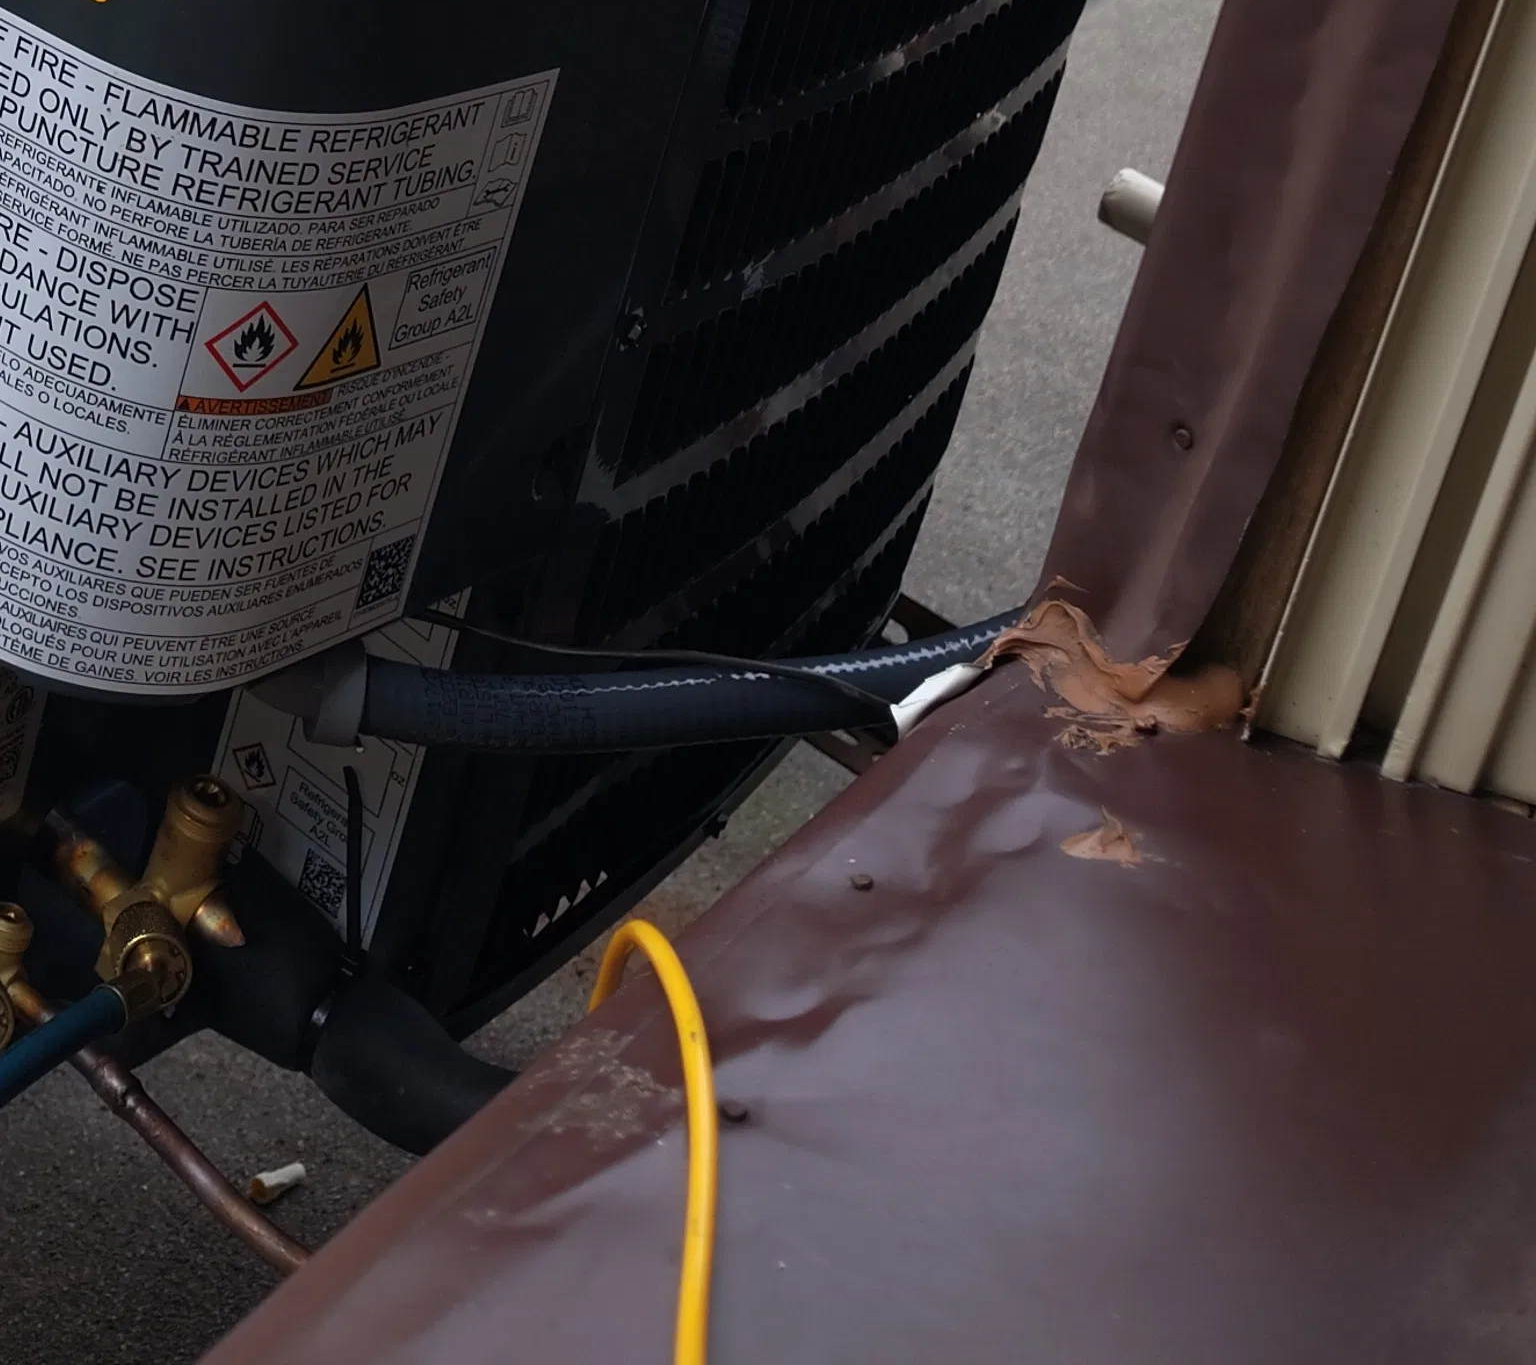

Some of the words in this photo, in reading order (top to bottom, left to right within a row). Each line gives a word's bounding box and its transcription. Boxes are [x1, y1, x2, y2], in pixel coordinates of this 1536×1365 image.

[13, 35, 79, 80] FIRE
[103, 80, 302, 153] FLAMMABLE
[307, 101, 486, 154] REFRIGERANT
[39, 87, 121, 142] ONLY
[125, 126, 173, 160] BY
[180, 143, 320, 186] TRAINED
[327, 143, 437, 186] SERVICE
[110, 185, 214, 228] INFLAMABLE
[217, 216, 303, 236] UTILIZADO.
[170, 172, 389, 215] REFRIGERANT
[393, 151, 477, 201] TUBING.
[56, 245, 196, 314] DISPOSE
[406, 252, 492, 294] Refrigerant
[417, 285, 468, 313] Safety
[110, 299, 193, 345] WITH
[393, 316, 442, 343] Group
[443, 302, 474, 328] A2L
[27, 333, 116, 392] USED.
[13, 421, 182, 490] AUXILIARY
[186, 458, 311, 493] DEVICES
[316, 429, 393, 476] WHICH
[393, 411, 444, 448] MAY
[38, 461, 109, 504] NOT
[114, 487, 160, 518] BE
[167, 482, 318, 522] INSTALLED
[321, 471, 347, 500] IN
[352, 454, 396, 488] THE
[148, 520, 278, 550] DEVICES
[282, 491, 363, 538] LISTED
[365, 472, 413, 508] FOR
[135, 555, 200, 582] SEE
[206, 509, 386, 582] INSTRUCTIONS.
[308, 823, 331, 849] A2L
[325, 820, 347, 843] Gro
